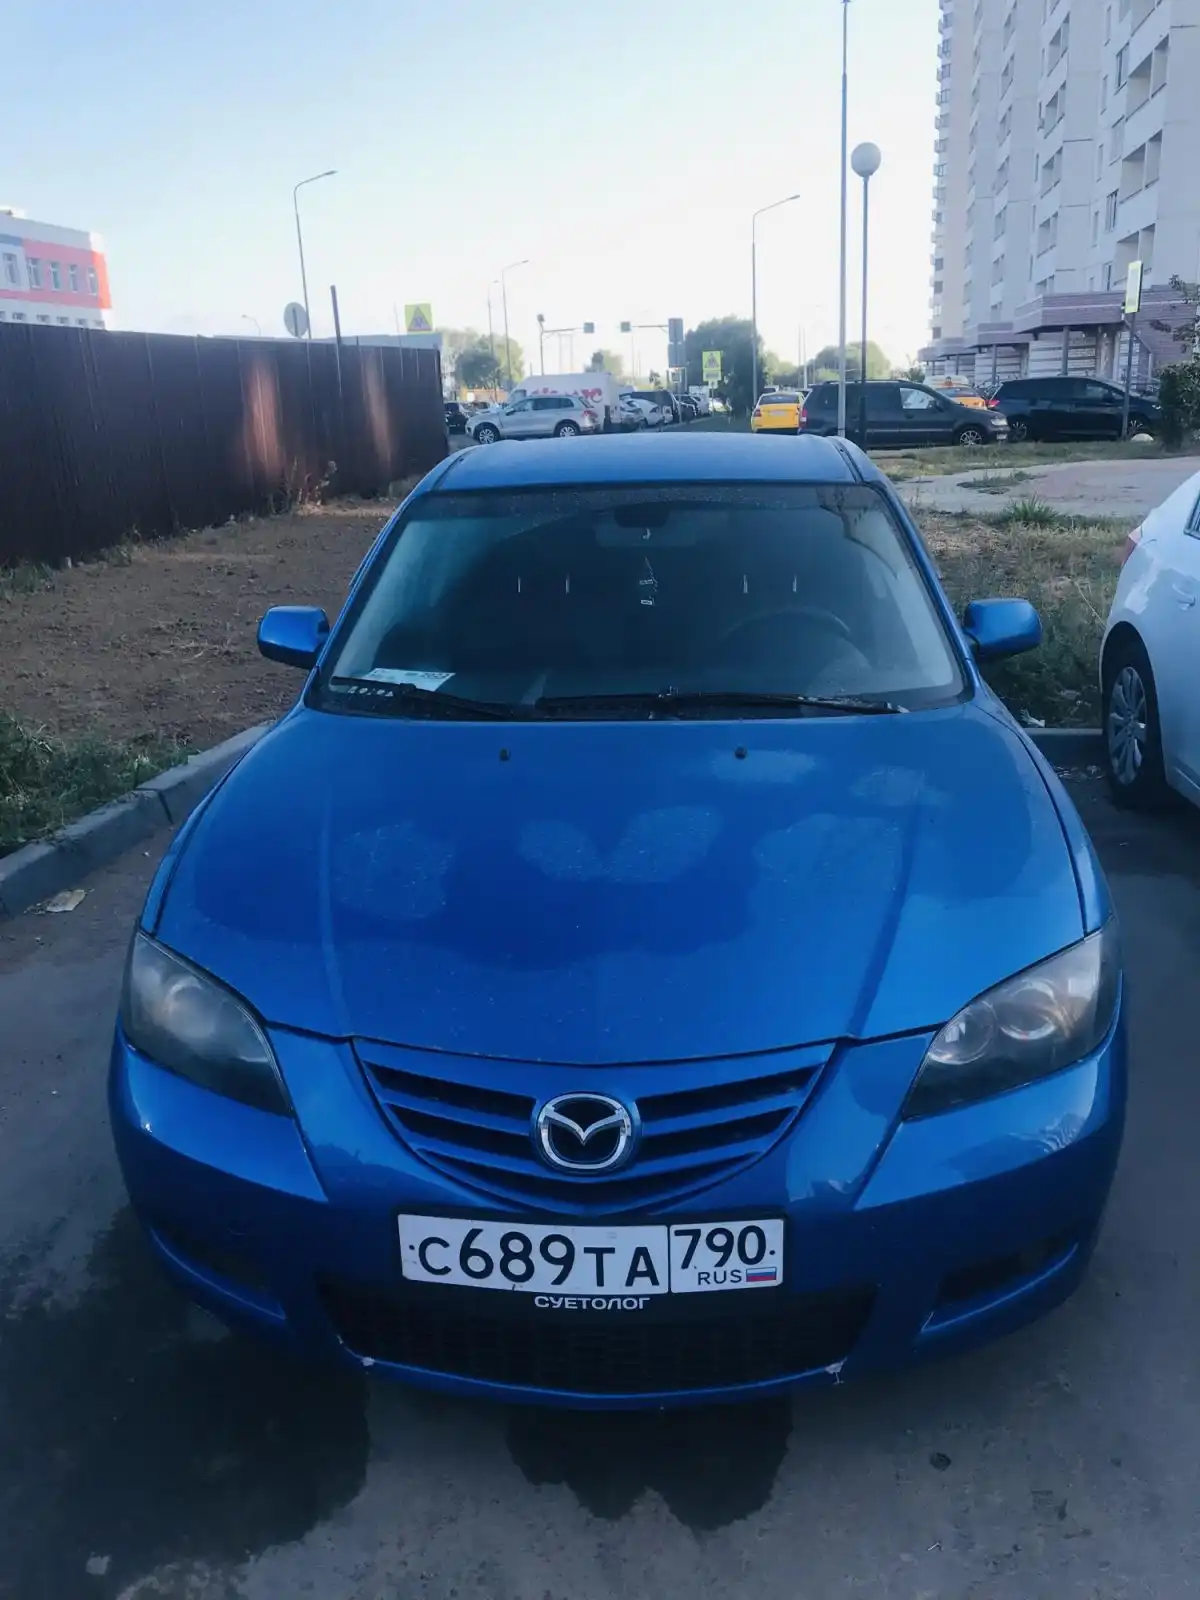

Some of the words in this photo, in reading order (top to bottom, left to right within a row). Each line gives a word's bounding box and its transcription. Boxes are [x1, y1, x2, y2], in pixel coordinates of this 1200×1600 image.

[418, 1228, 660, 1288] С689ТА
[674, 1225, 767, 1269] 790
[697, 1269, 743, 1286] RUS
[534, 1295, 651, 1310] СУЕТОЛОГ
